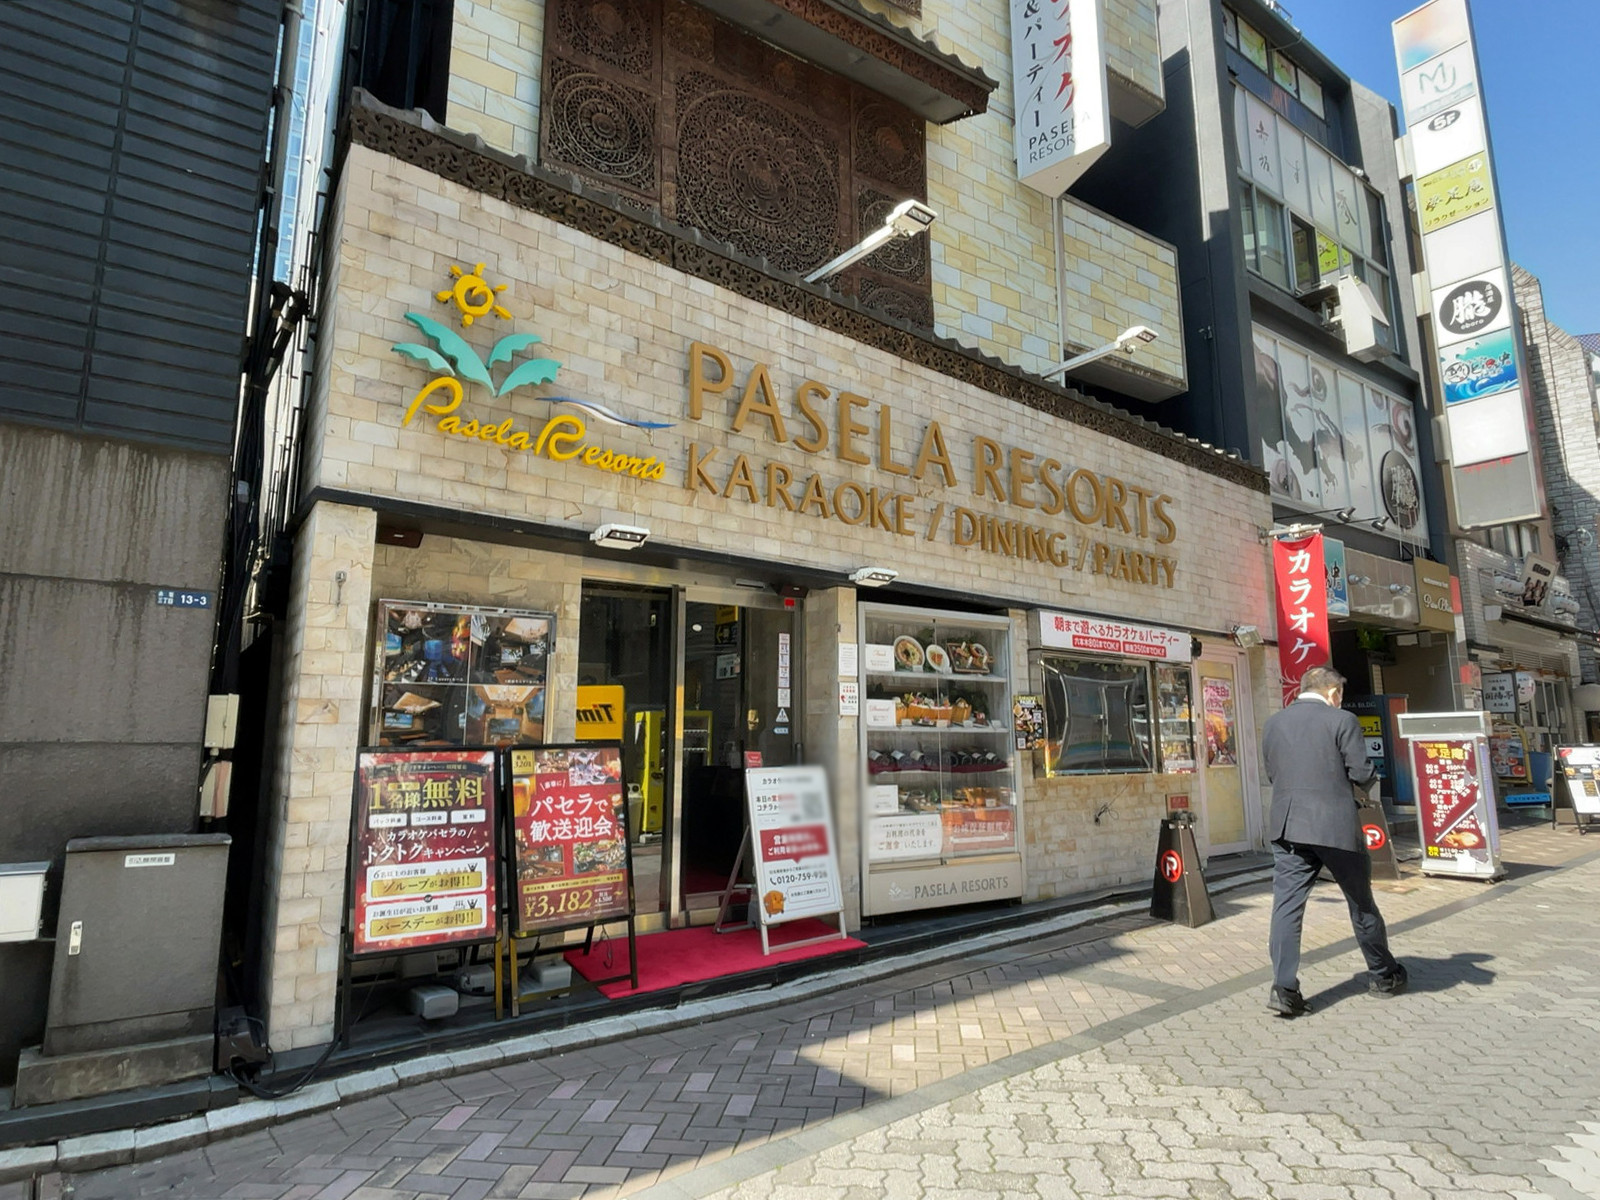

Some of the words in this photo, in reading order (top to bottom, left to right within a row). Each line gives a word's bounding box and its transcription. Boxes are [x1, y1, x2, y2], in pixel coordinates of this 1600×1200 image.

[1029, 133, 1076, 163] RESOR
[403, 376, 533, 451] Pasela
[534, 415, 665, 480] Resorts
[688, 341, 957, 487] PASELA
[974, 435, 1177, 544] RESORTS
[686, 443, 916, 536] KARAOKE
[954, 507, 1069, 567] DINING
[1094, 542, 1178, 588] PARTY
[181, 594, 207, 605] 13-3
[1288, 549, 1318, 665] カラオケ
[531, 793, 609, 817] パセラで
[530, 815, 613, 843] 歓送迎会
[368, 843, 485, 864] トクトクキャンペーン
[914, 882, 957, 899] PASELA
[961, 876, 1009, 893] RESORTS
[373, 904, 438, 918] お誕生日が近いお客様
[525, 889, 593, 918] ¥3,182
[378, 911, 474, 932] バースデーがお得!!
